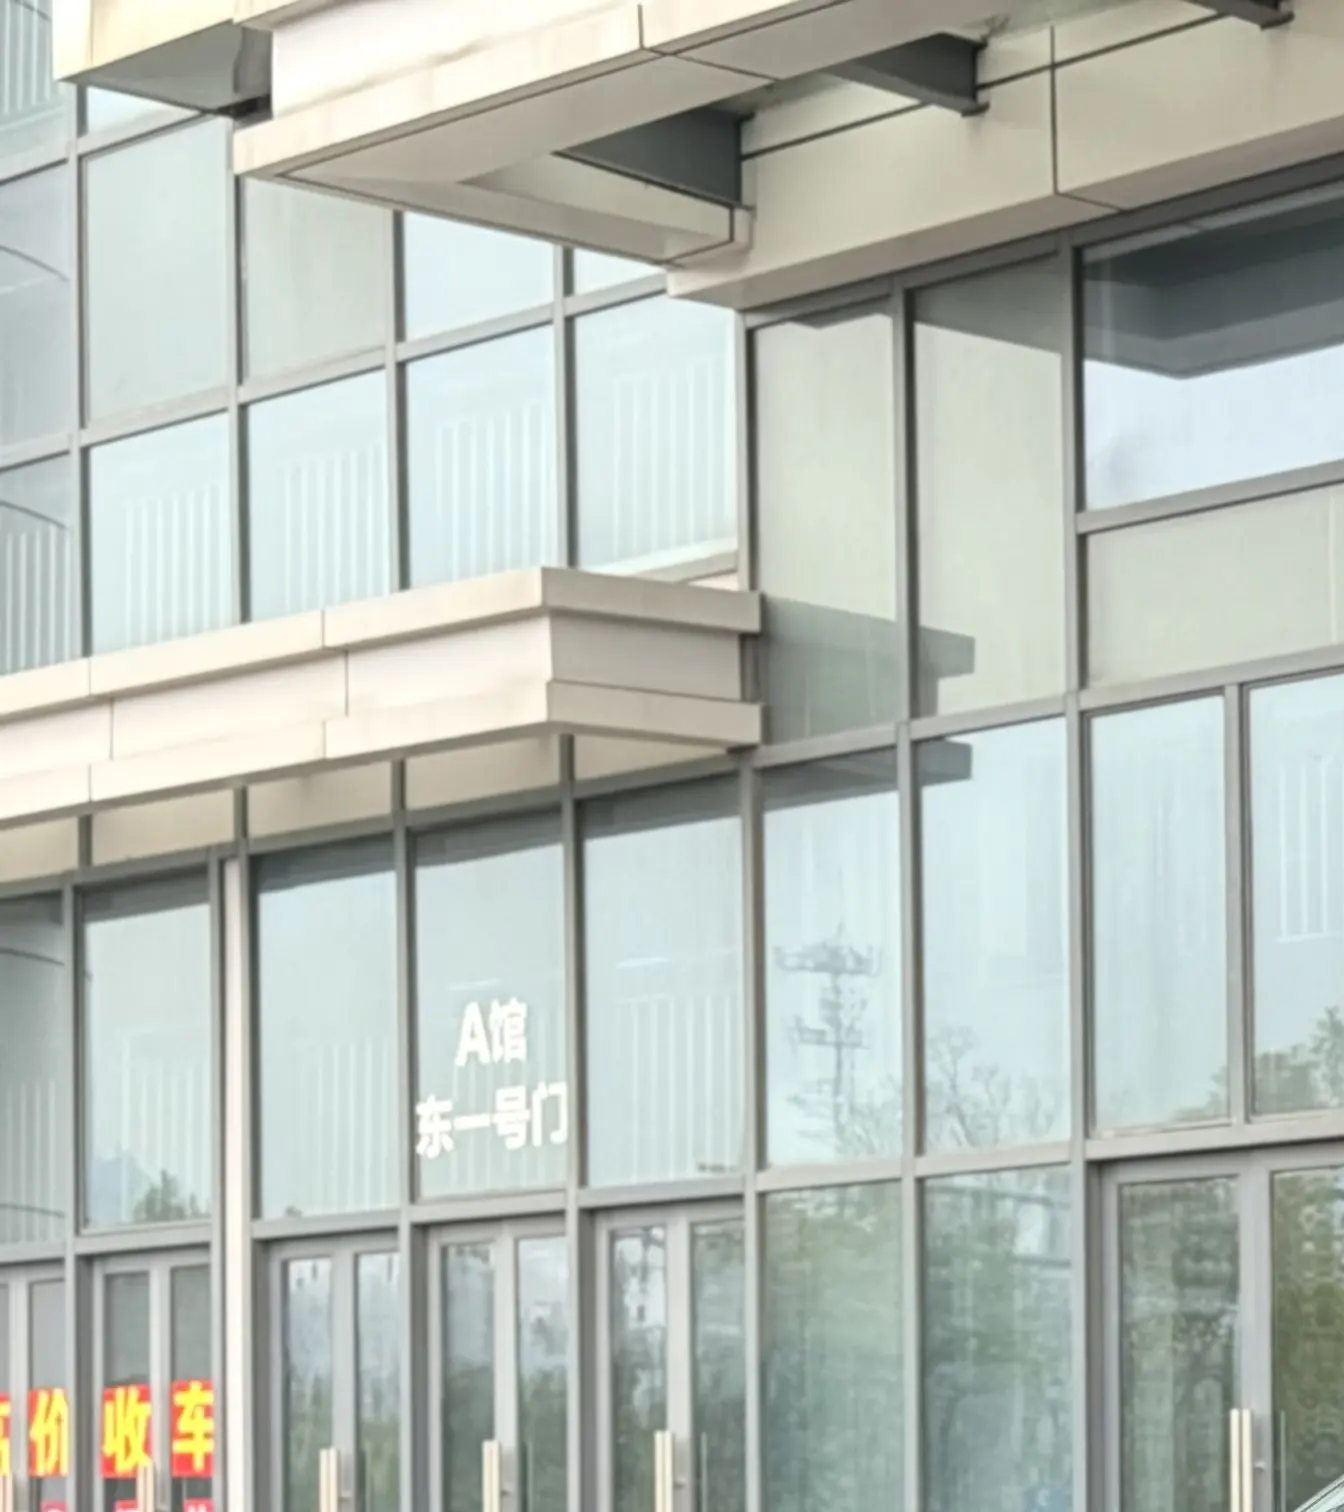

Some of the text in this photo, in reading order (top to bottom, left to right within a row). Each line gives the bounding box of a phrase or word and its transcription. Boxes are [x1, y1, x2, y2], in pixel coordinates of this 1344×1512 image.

[455, 997, 527, 1066] A馆
[415, 1081, 568, 1158] 东一号门
[0, 1380, 214, 1477] 价收车
